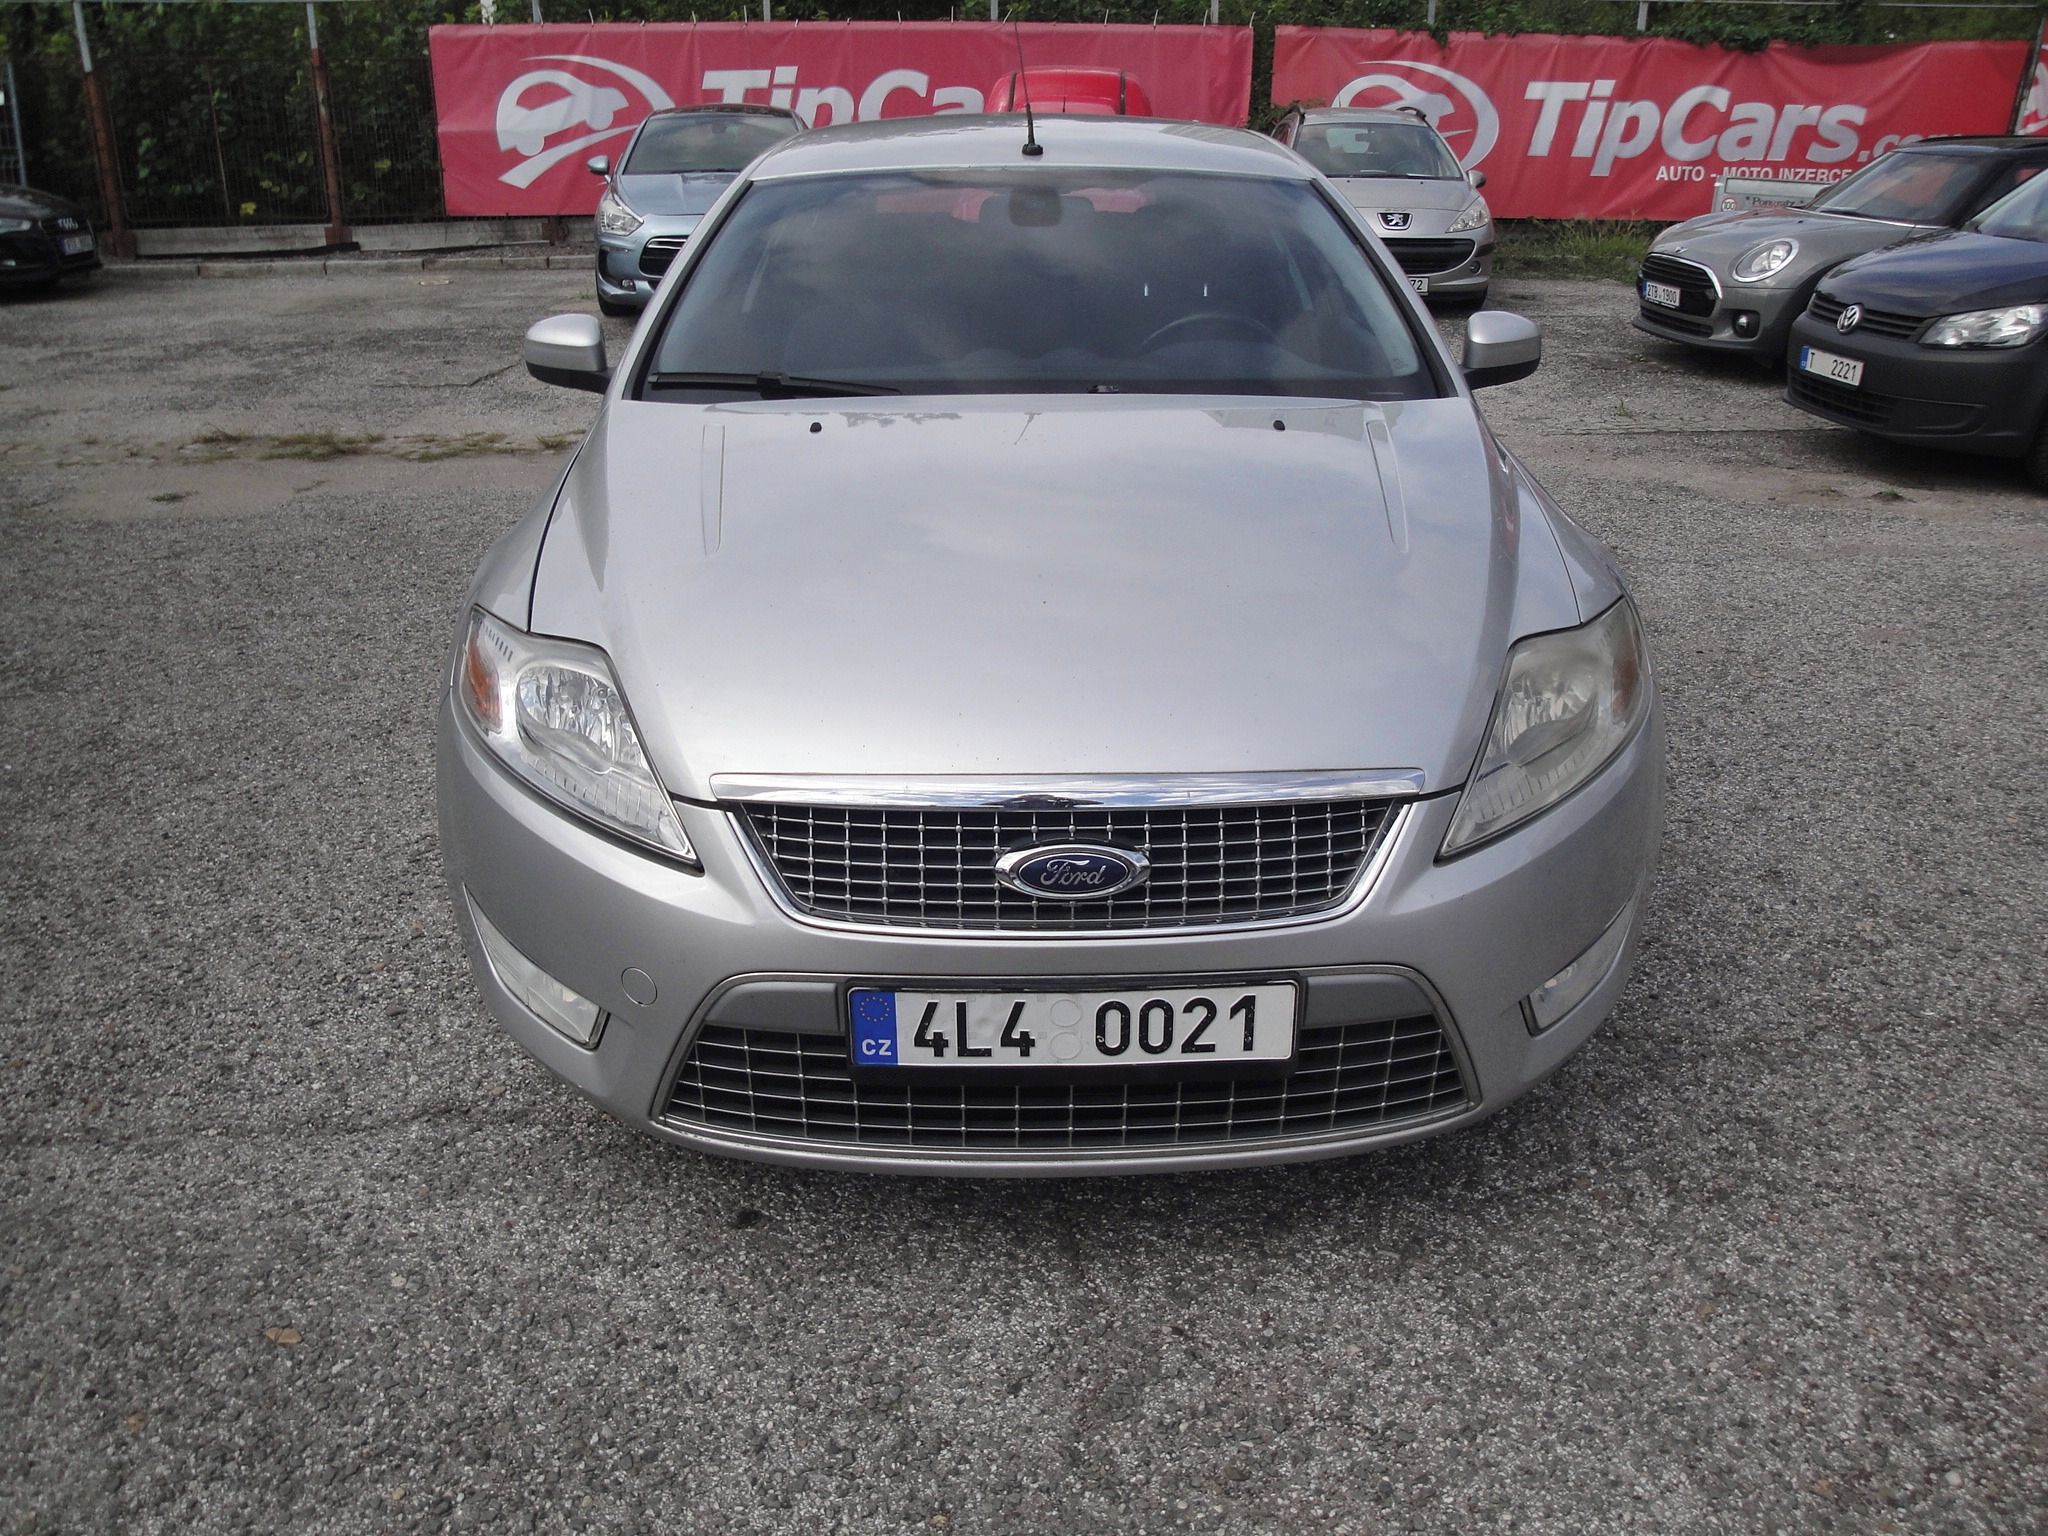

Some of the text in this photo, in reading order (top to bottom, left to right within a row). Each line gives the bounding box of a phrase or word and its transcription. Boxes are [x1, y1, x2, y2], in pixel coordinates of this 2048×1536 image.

[1655, 165, 1705, 182] AUTO
[1723, 166, 1773, 181] MOTO
[1777, 167, 1853, 184] INZERCE
[1810, 351, 1857, 382] T 2221
[1041, 859, 1106, 886] Ford
[913, 994, 1257, 1058] 4L4 0021
[861, 1038, 893, 1057] CZ
